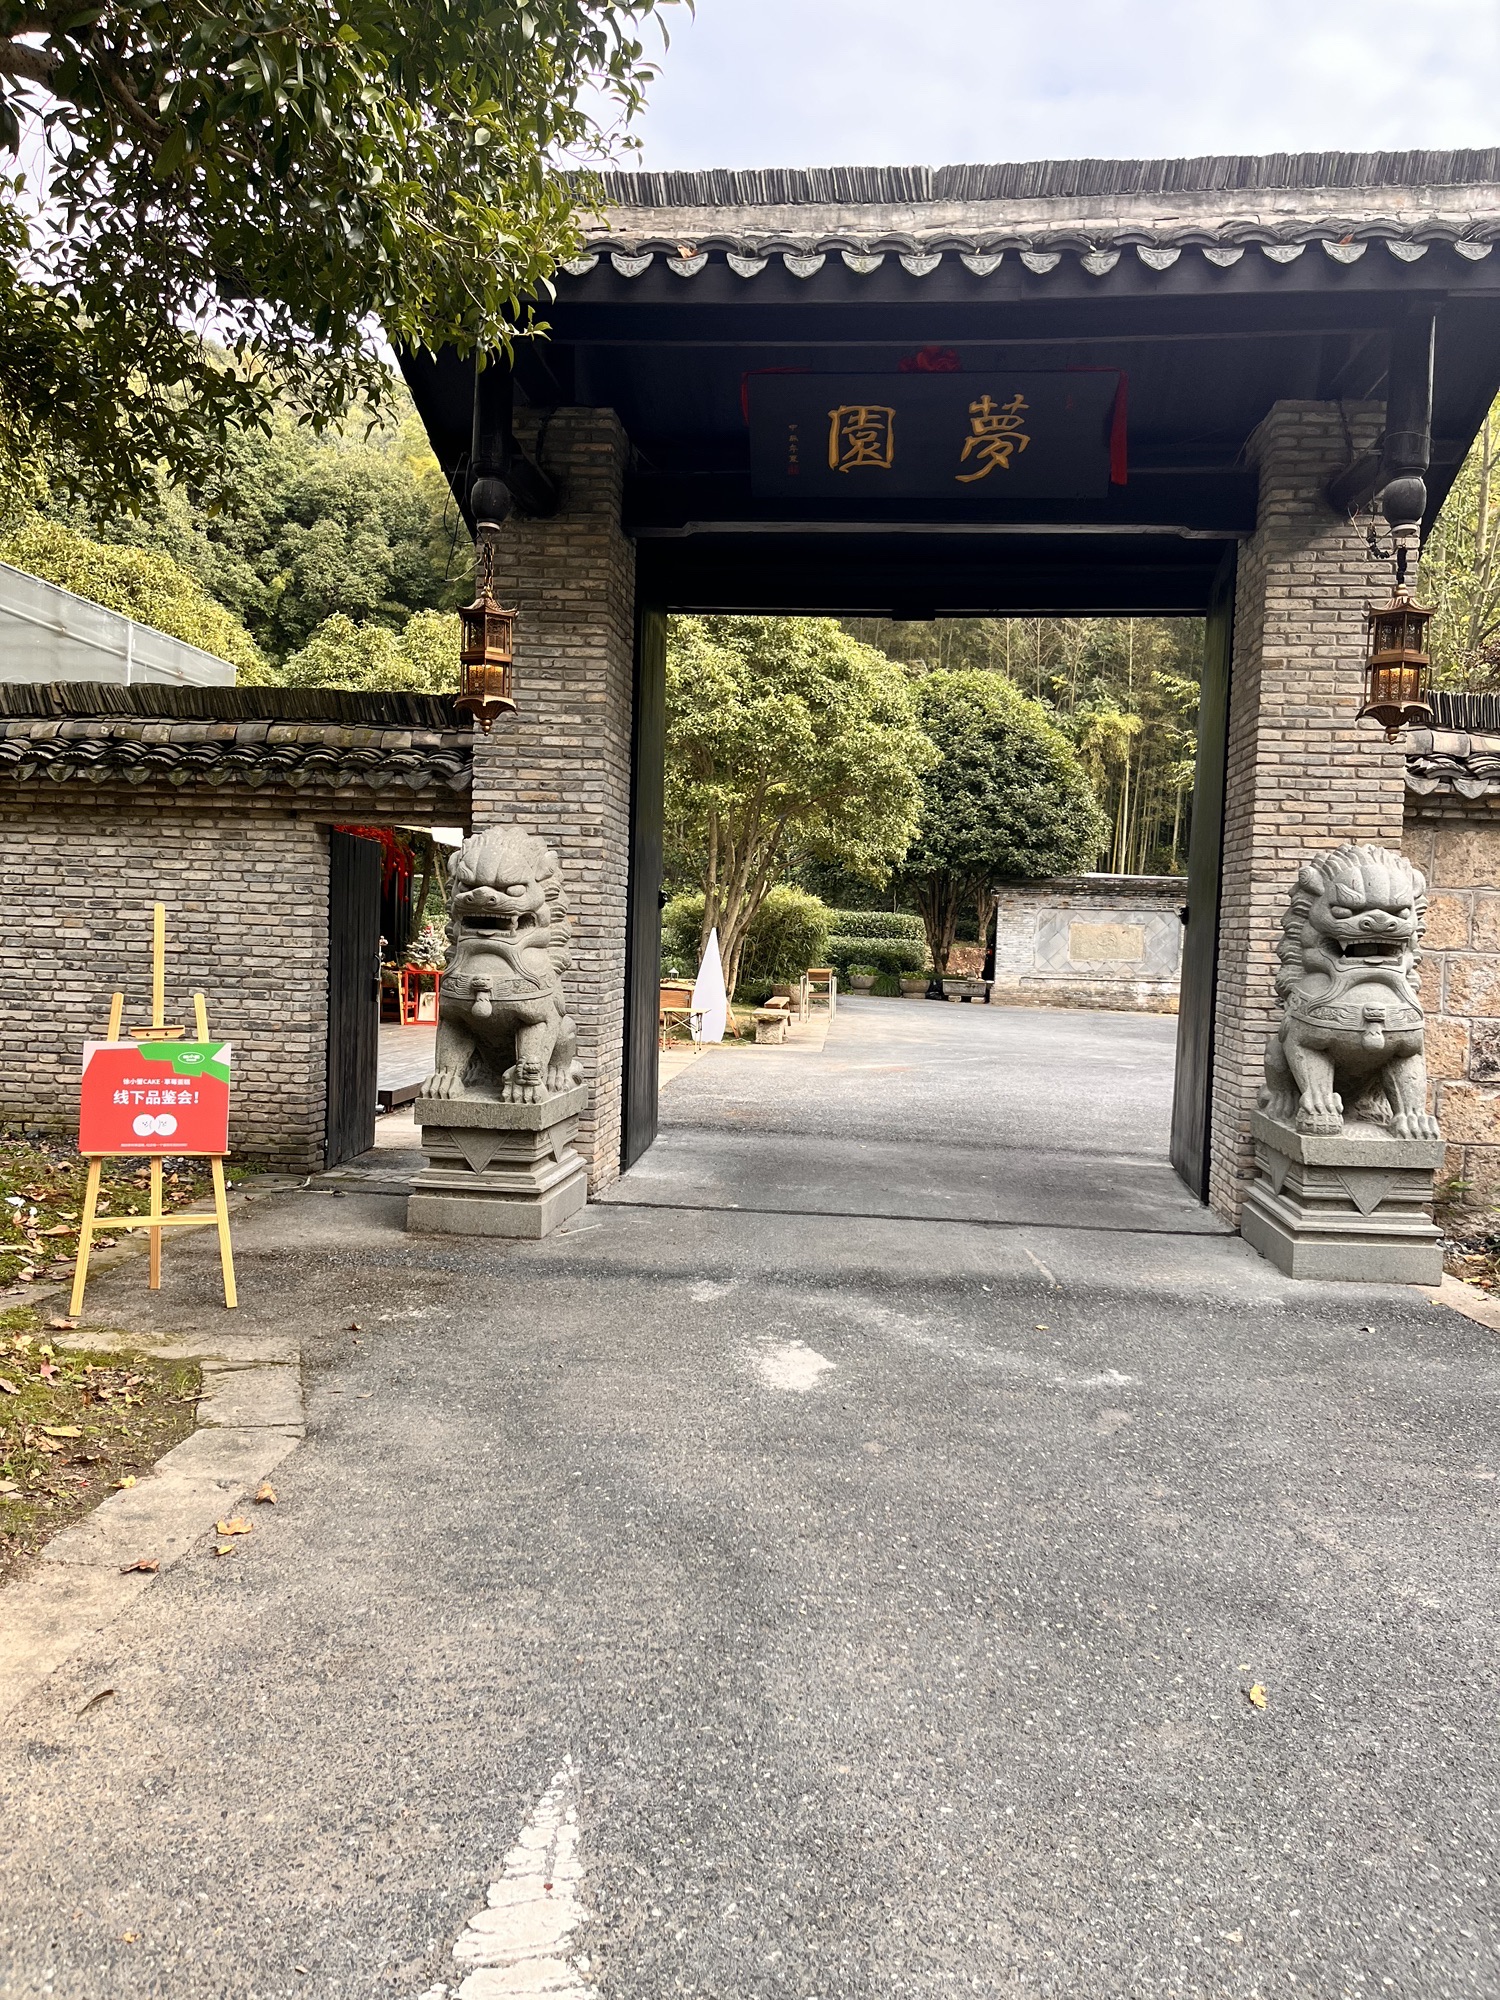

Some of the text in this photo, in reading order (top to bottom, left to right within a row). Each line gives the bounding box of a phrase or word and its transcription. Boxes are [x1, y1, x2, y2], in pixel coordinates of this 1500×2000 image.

[113, 1090, 199, 1105] 线下品鉴会！
